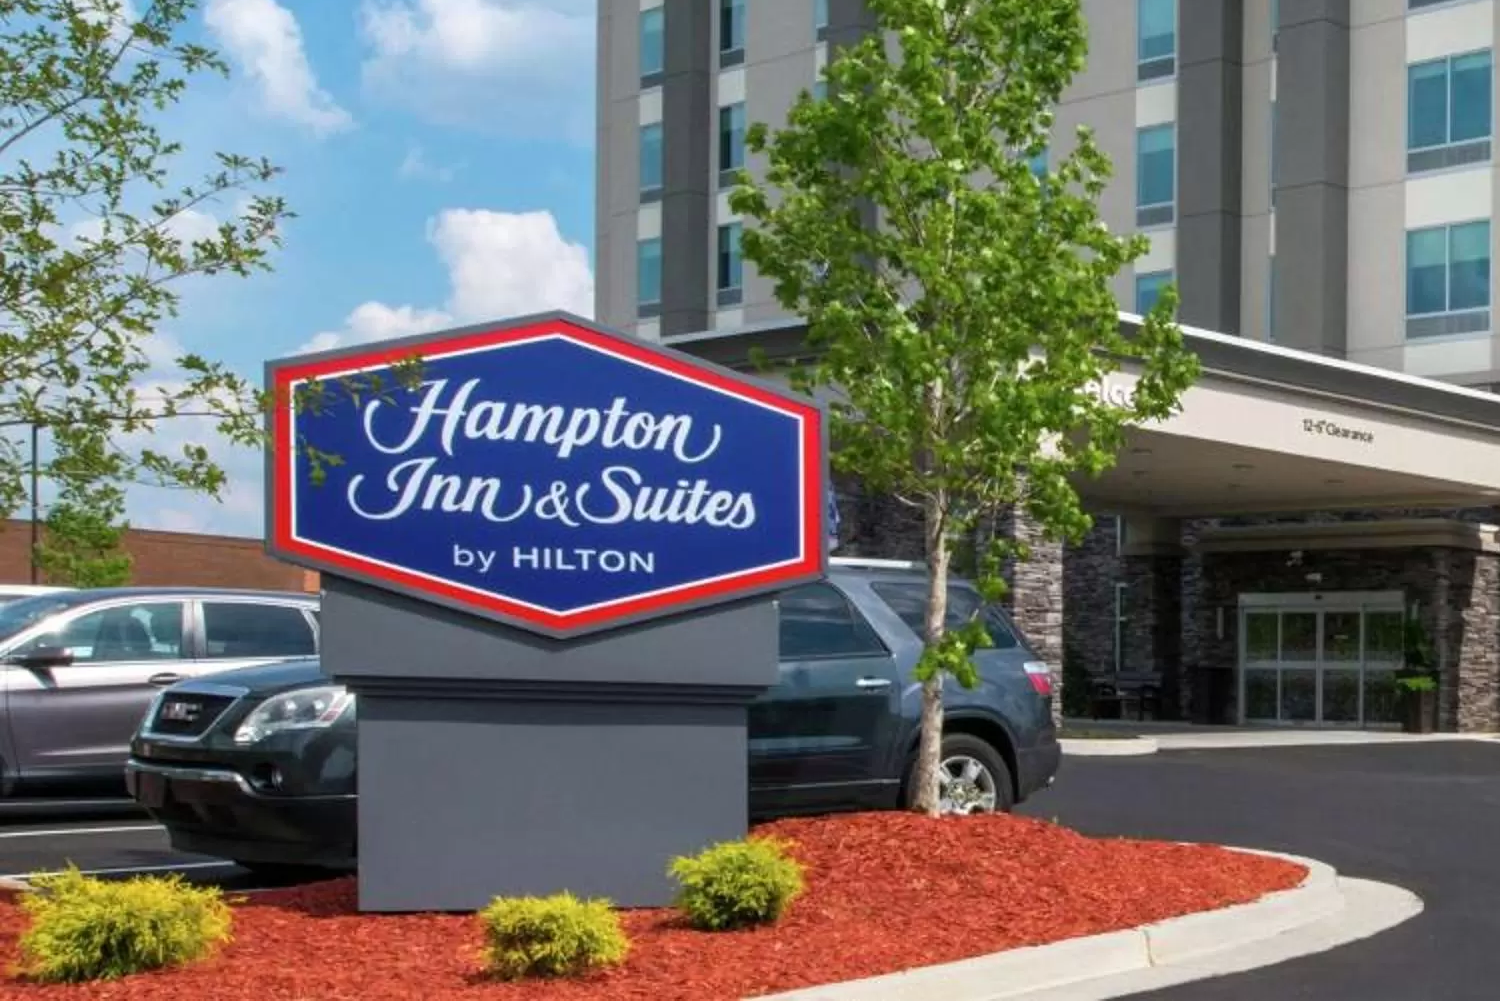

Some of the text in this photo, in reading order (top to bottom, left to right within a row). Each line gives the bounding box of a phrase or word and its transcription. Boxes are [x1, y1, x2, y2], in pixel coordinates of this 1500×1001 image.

[363, 378, 721, 462] Hampton
[347, 456, 757, 529] Inn & Suites
[452, 544, 655, 574] by HILTON
